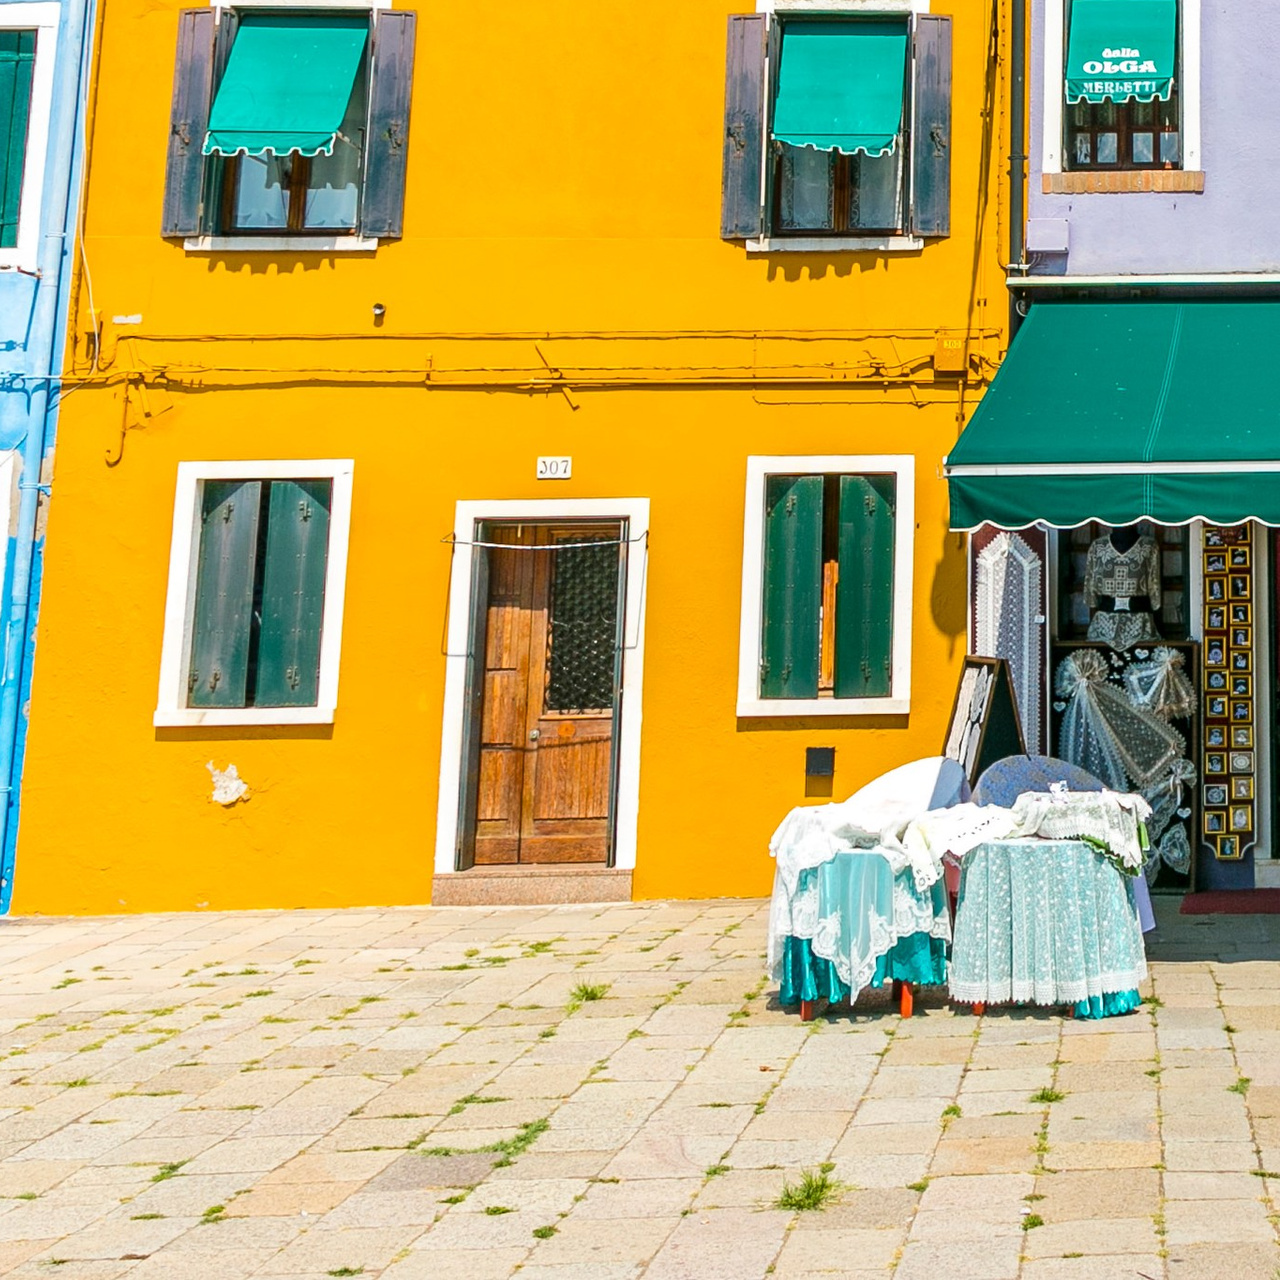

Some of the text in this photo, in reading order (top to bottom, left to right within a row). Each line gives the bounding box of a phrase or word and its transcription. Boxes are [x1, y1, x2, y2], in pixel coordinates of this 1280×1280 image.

[1101, 47, 1140, 58] dalla
[1082, 60, 1157, 74] OLGA
[1083, 81, 1156, 94] MERLETTI
